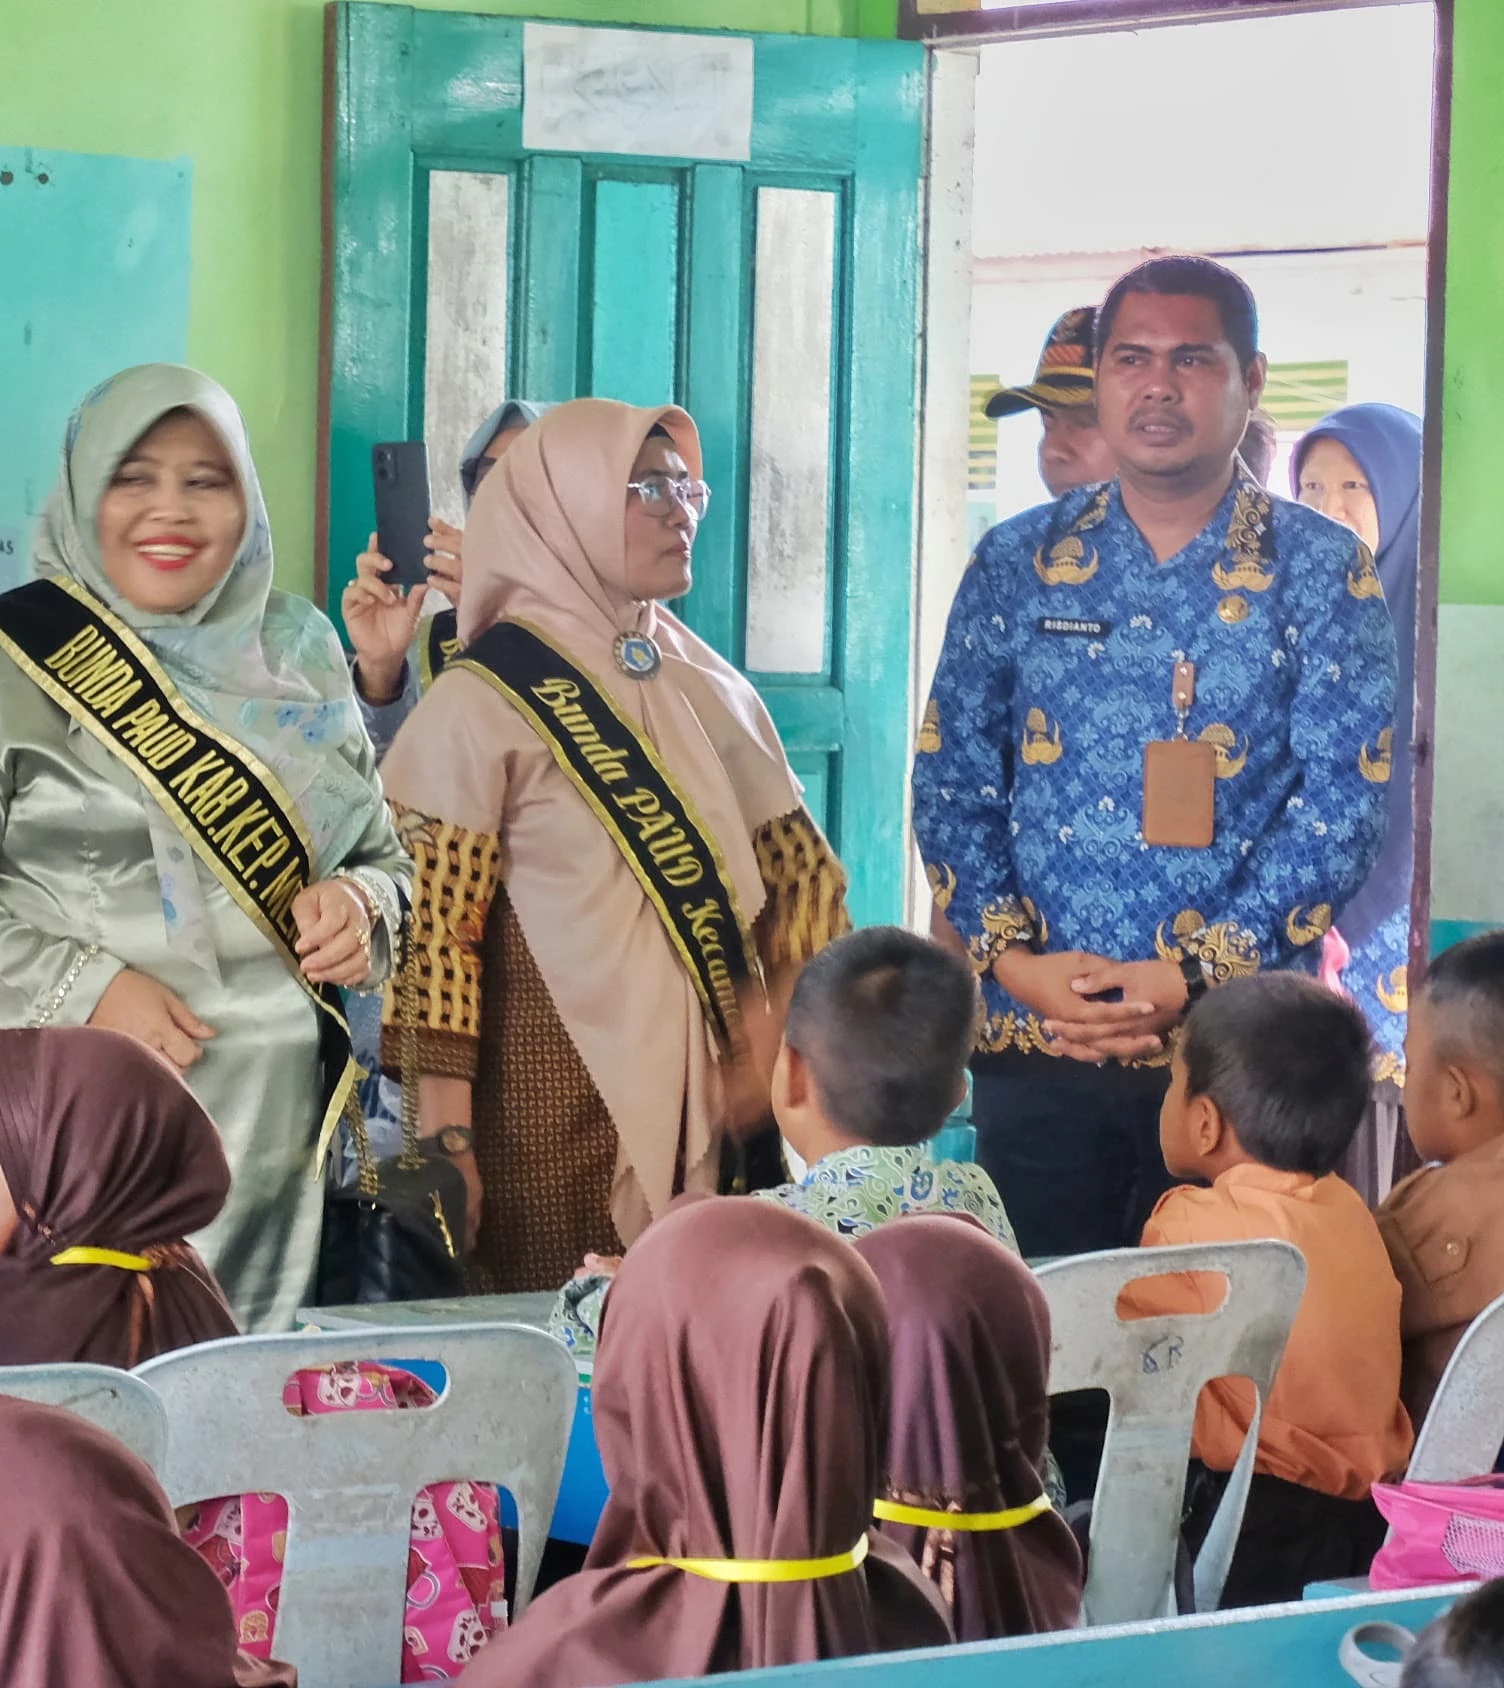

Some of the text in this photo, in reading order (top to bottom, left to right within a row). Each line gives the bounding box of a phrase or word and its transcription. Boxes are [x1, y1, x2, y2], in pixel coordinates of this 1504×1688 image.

[44, 623, 144, 719] BUNDA
[111, 697, 196, 771] PAUD
[529, 676, 630, 786] Bunda
[611, 785, 704, 889] PAUD
